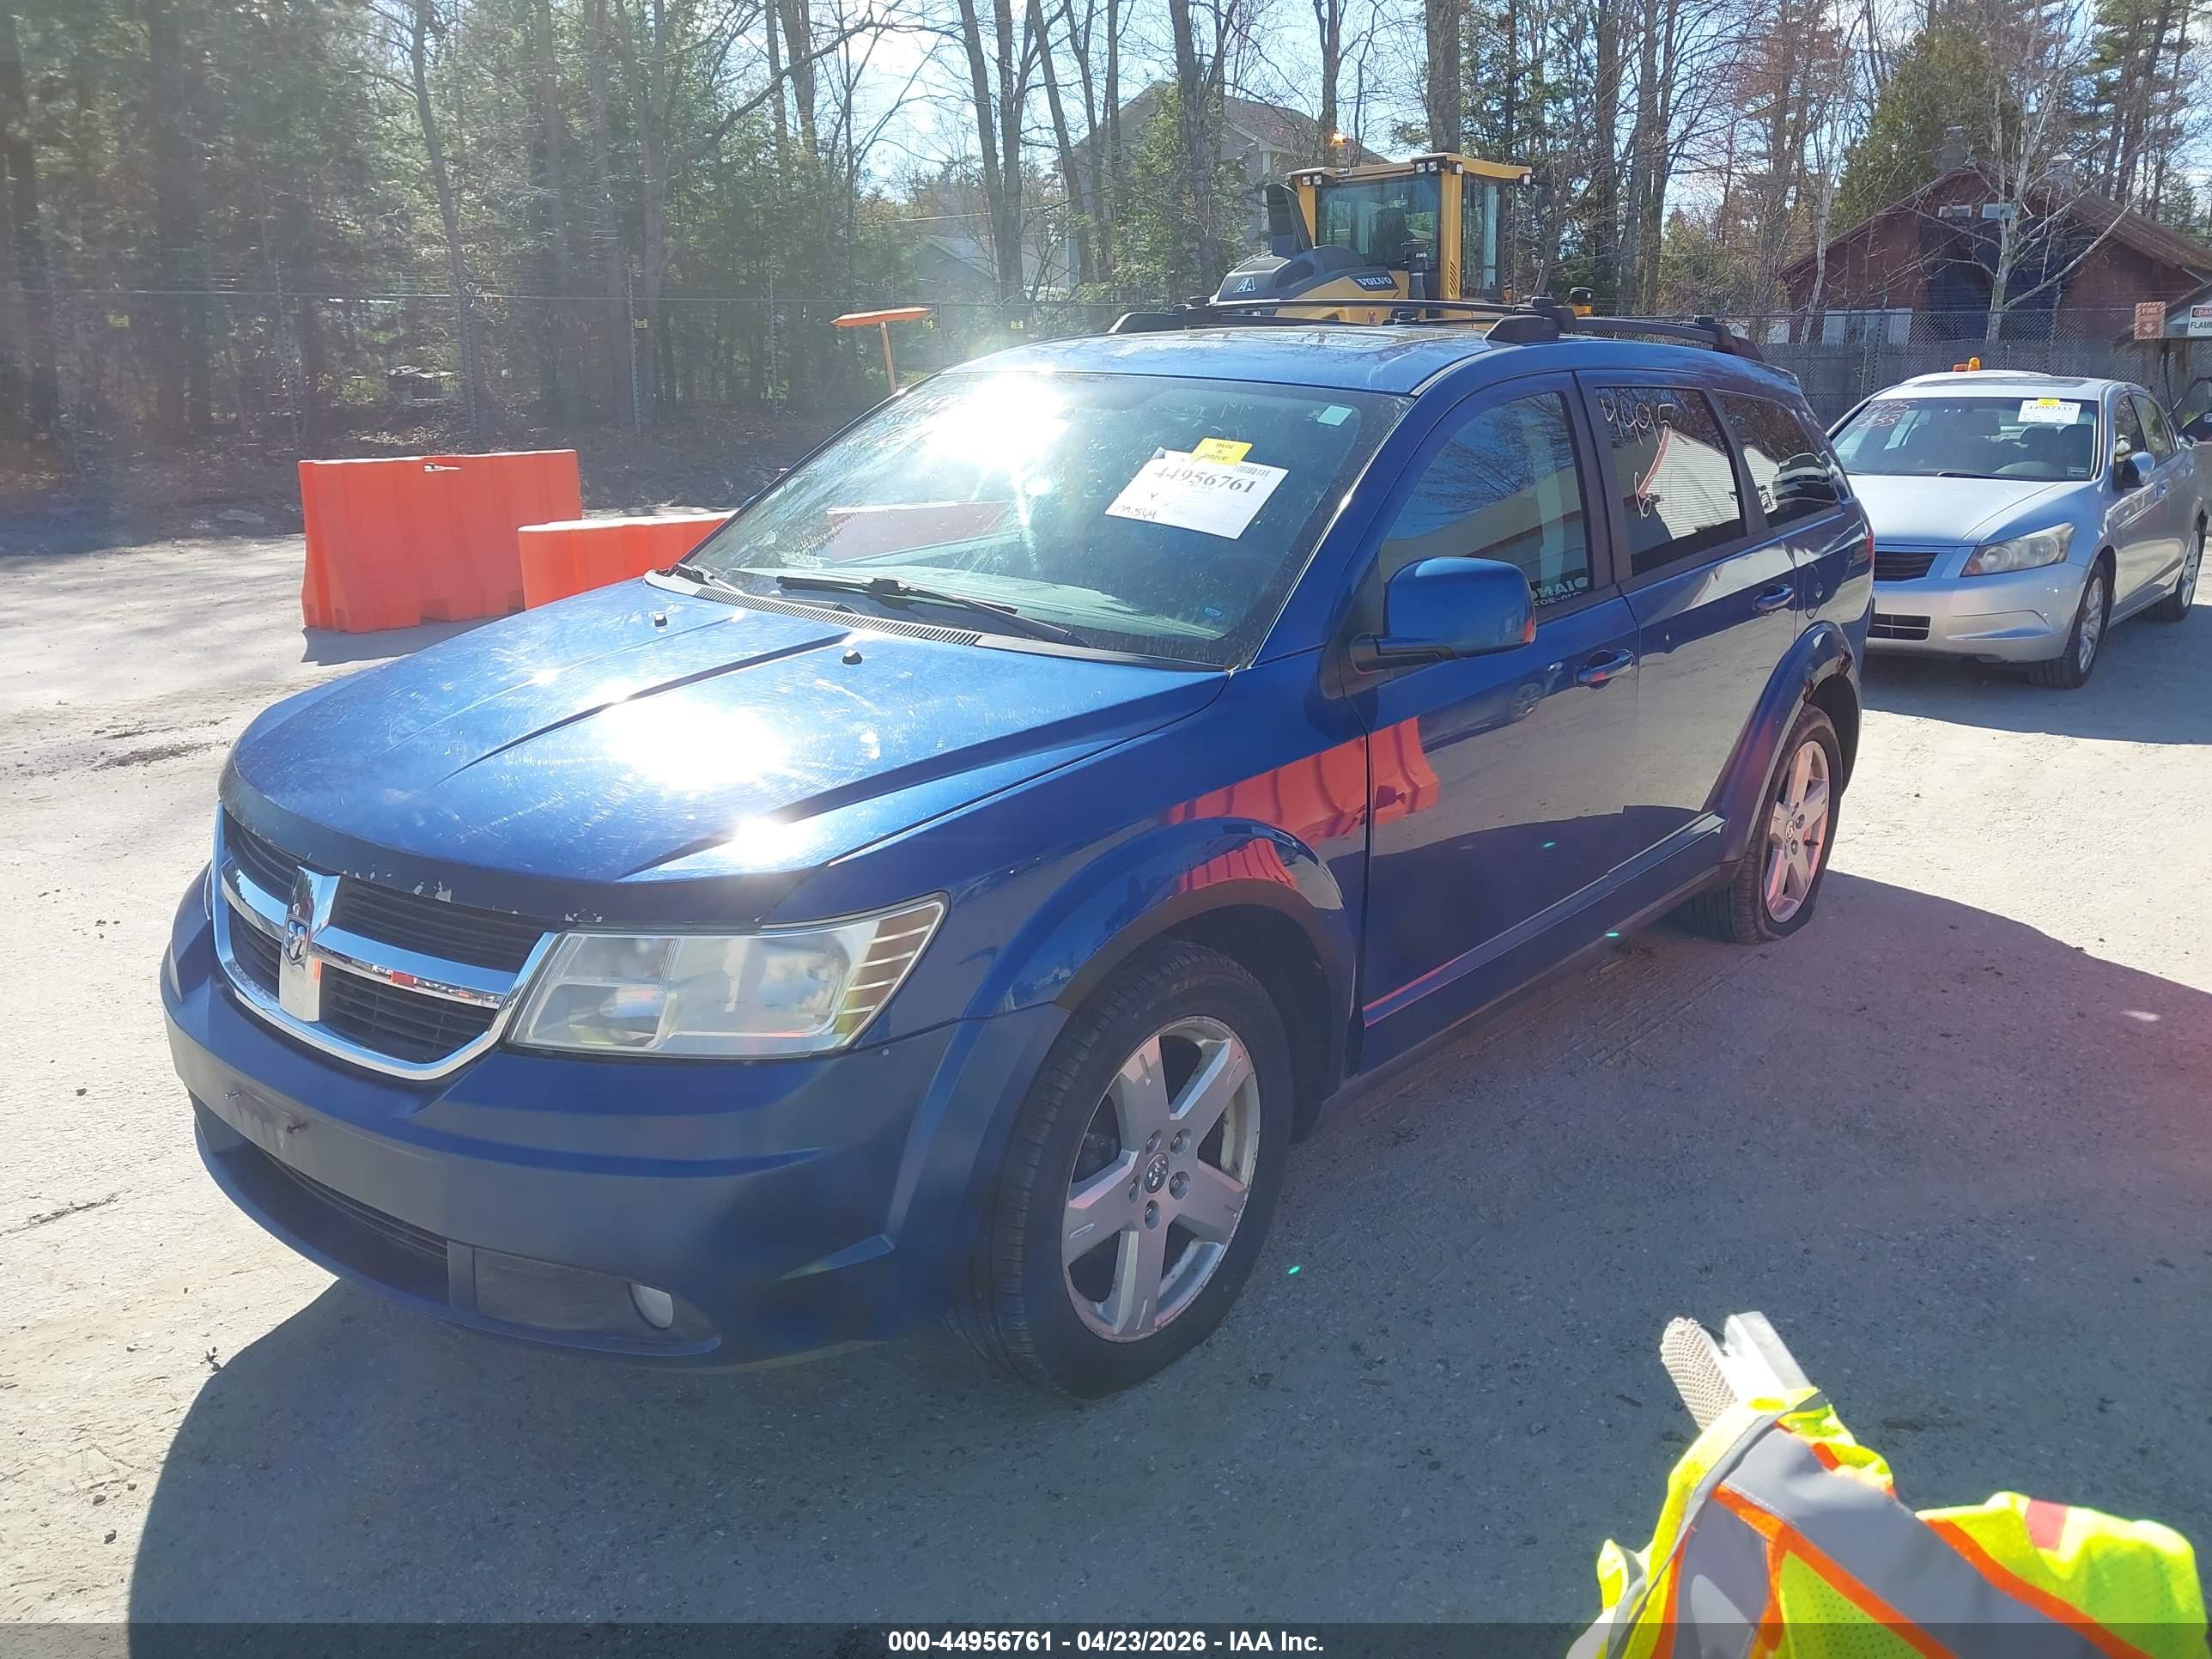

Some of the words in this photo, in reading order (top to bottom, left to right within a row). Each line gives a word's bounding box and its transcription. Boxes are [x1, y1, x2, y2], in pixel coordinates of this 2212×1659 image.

[1357, 276, 1392, 286] VOLVO
[1599, 398, 1675, 447] 4495
[1154, 466, 1257, 494] 44956761
